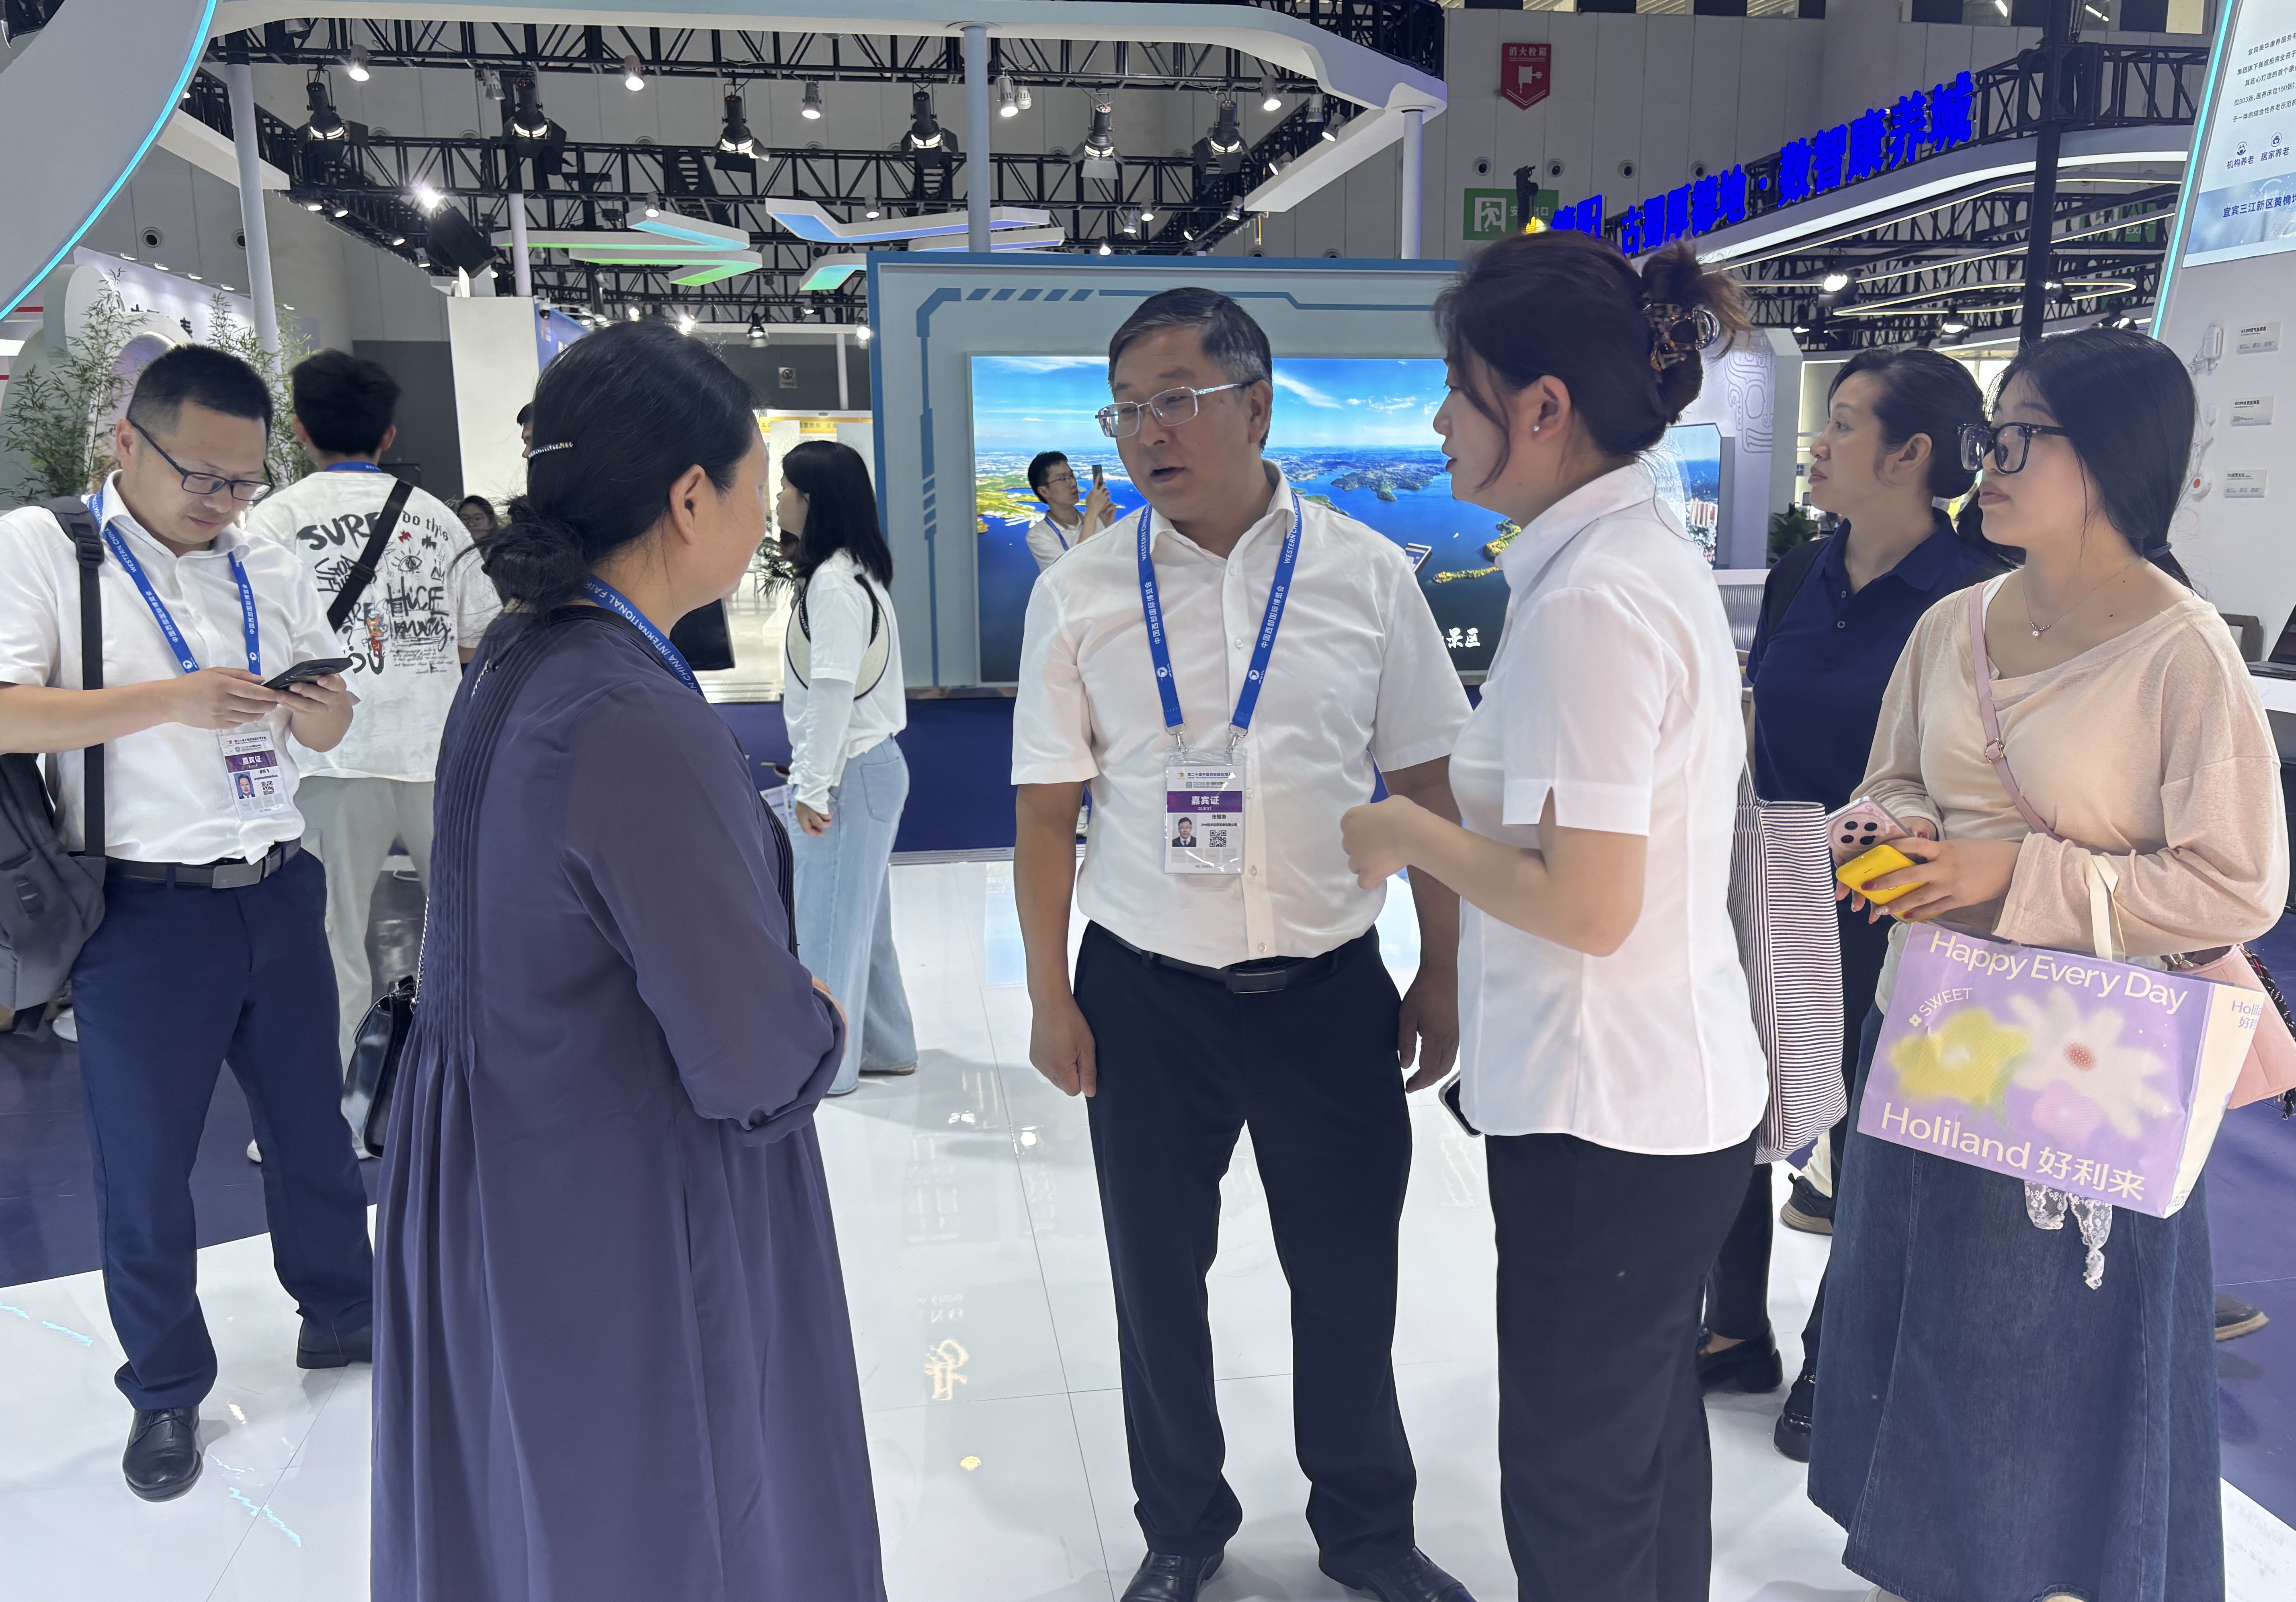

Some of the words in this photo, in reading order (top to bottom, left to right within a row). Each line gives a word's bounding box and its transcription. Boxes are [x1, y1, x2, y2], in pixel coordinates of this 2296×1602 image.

[1509, 47, 1547, 56] 消火栓箱
[2227, 156, 2254, 169] 机构养老
[2260, 147, 2290, 161] 居家养老
[1510, 205, 1548, 216] 安出口
[2126, 226, 2148, 234] EXI
[115, 544, 137, 573] WESTERN
[1283, 533, 1296, 564] WESTERN
[609, 595, 672, 656] INTERNATIONAL
[1144, 581, 1161, 644] 中国西部国际博览会
[1261, 585, 1285, 648] 中国西部国际博览会
[1441, 627, 1480, 648] 景区
[668, 654, 691, 681] CHINA
[1191, 796, 1220, 805] 嘉宾证
[1929, 931, 2028, 981] Happy
[2030, 955, 2121, 998] Every
[2124, 971, 2189, 1014] Day
[1918, 987, 1973, 1017] SWEET
[1881, 1102, 2031, 1170] Holiland
[2038, 1146, 2145, 1202] 好利来
